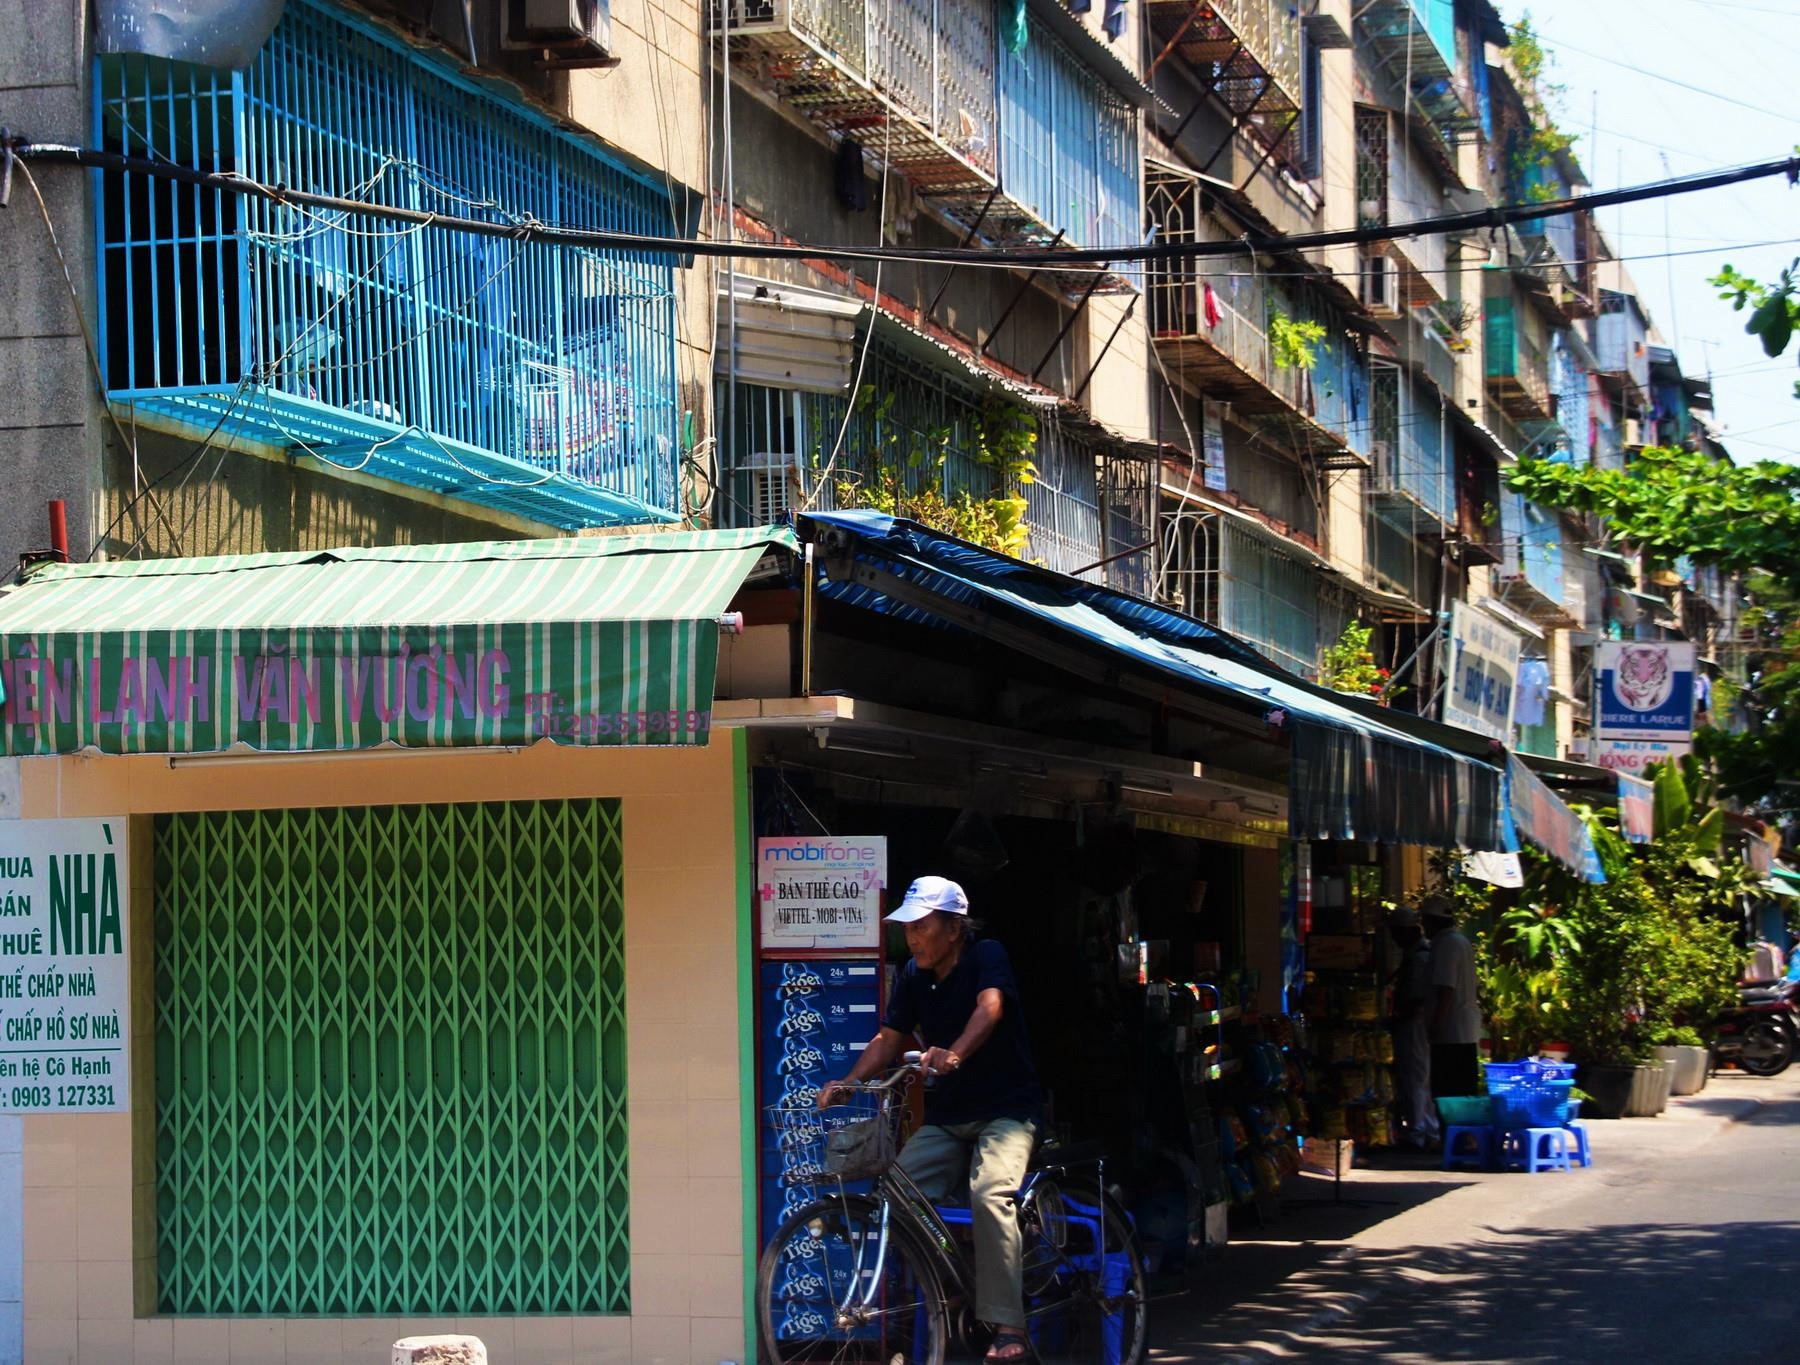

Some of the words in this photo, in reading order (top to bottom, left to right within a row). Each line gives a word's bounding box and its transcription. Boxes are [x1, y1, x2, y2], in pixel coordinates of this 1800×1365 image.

[89, 656, 209, 737] LẠNH
[233, 641, 321, 724] VĂN
[1640, 714, 1686, 725] LARUE
[765, 842, 876, 861] mobifone
[49, 823, 122, 956] NHÀ
[778, 877, 802, 900] BÁN
[833, 876, 859, 900] CÀO
[0, 890, 31, 917] ÁN
[778, 907, 811, 924] VIETTEL
[816, 907, 838, 924] MOBI
[842, 907, 863, 924] VINA
[0, 927, 42, 955] HUÊ
[28, 964, 64, 998] CHẤP
[68, 967, 96, 997] NHÀ
[830, 968, 845, 977] 24x
[831, 1005, 846, 1014] 24x
[6, 1007, 42, 1041] CHẤP
[46, 1006, 65, 1041] HỒ
[69, 1012, 88, 1040] SƠ
[92, 1009, 120, 1039] NHÀ
[783, 1010, 823, 1034] Tiger
[784, 1047, 823, 1072] Tiger
[831, 1043, 846, 1052] 24x
[22, 1057, 40, 1081] hệ
[46, 1057, 66, 1076] Cô
[71, 1056, 111, 1079] Hạnh
[12, 1086, 51, 1107] 0903
[57, 1085, 115, 1106] 127331
[784, 1273, 824, 1297] Tiger
[784, 1311, 824, 1335] Tiger
